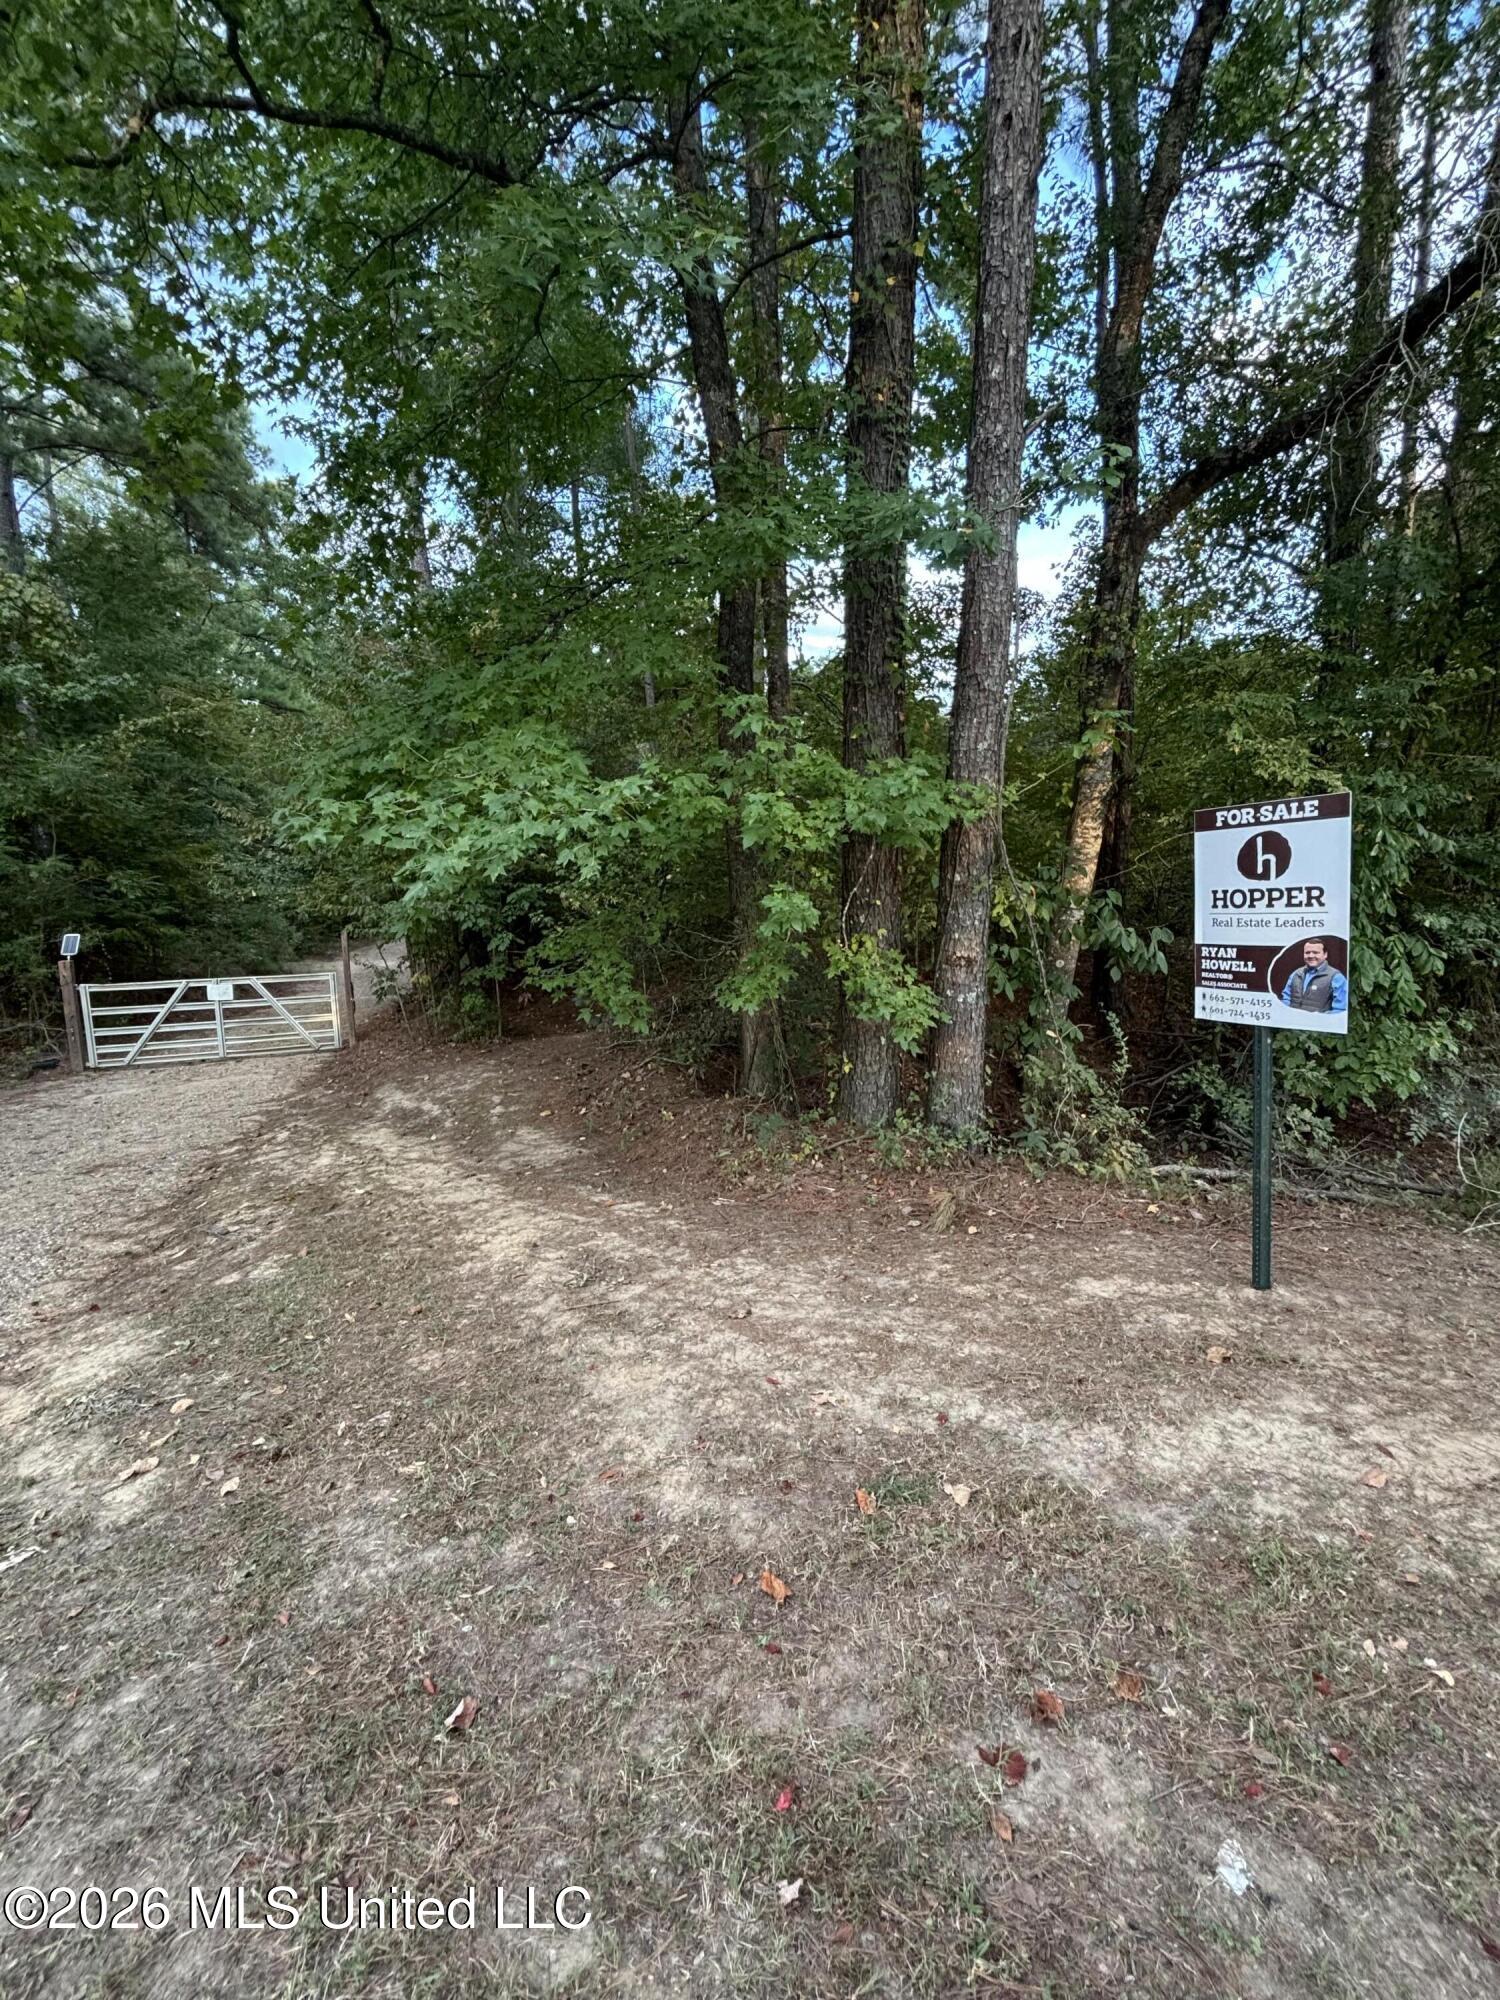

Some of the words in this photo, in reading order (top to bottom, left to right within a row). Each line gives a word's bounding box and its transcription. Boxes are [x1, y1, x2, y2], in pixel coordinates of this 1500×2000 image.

[1216, 808, 1255, 827] FOR
[1259, 799, 1319, 822] SALE
[1211, 886, 1325, 909] HOPPER
[1212, 917, 1233, 928] Real
[1236, 917, 1271, 928] Estate
[1275, 917, 1325, 928] Leaders
[1201, 946, 1237, 959] RYAN
[1201, 959, 1256, 973] HOWELL
[1217, 981, 1248, 989] ASSOCIATE
[1209, 993, 1273, 1008] 662-571-4155
